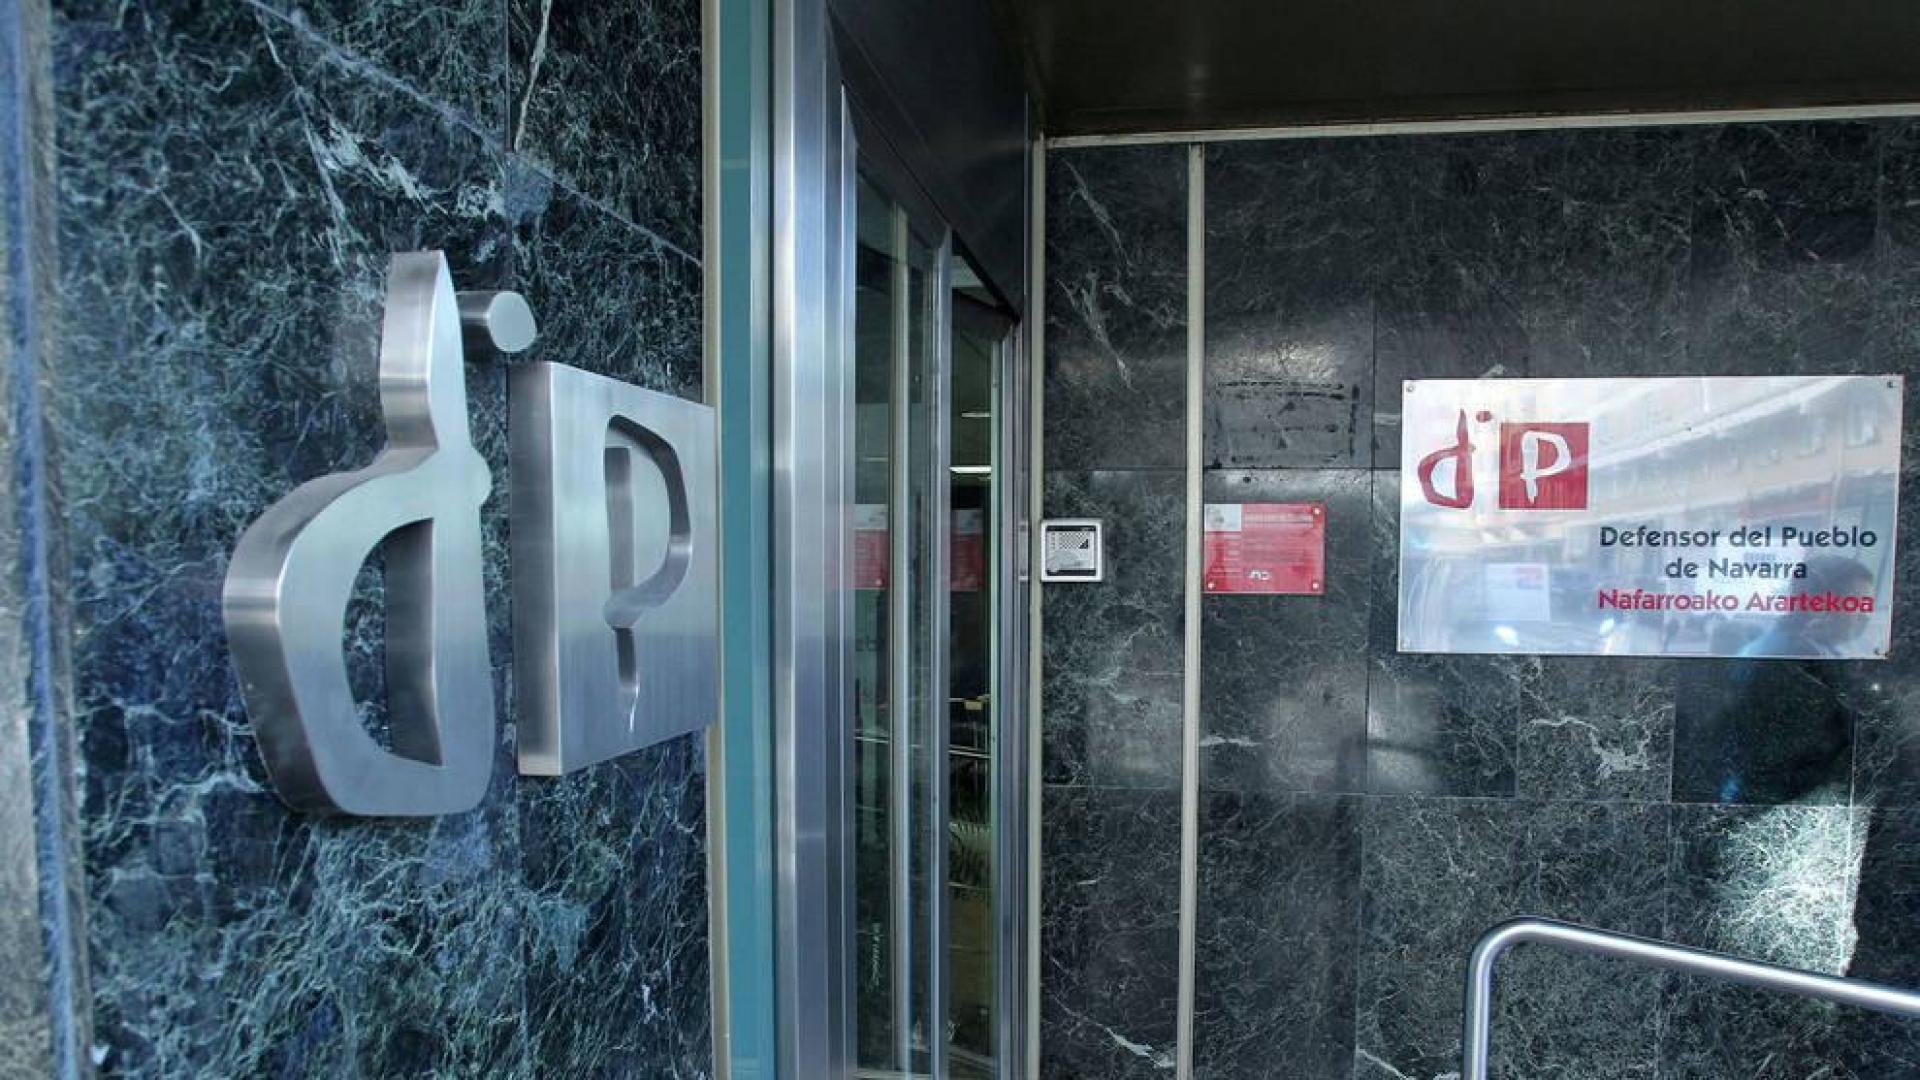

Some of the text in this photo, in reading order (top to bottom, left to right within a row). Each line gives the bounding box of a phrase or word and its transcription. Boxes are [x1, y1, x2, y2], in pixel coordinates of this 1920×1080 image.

[1600, 525, 1878, 548] Defensor del Pueblo
[1665, 558, 1808, 580] de Navarra
[1598, 589, 1875, 613] Nafarroako Arartekoa
